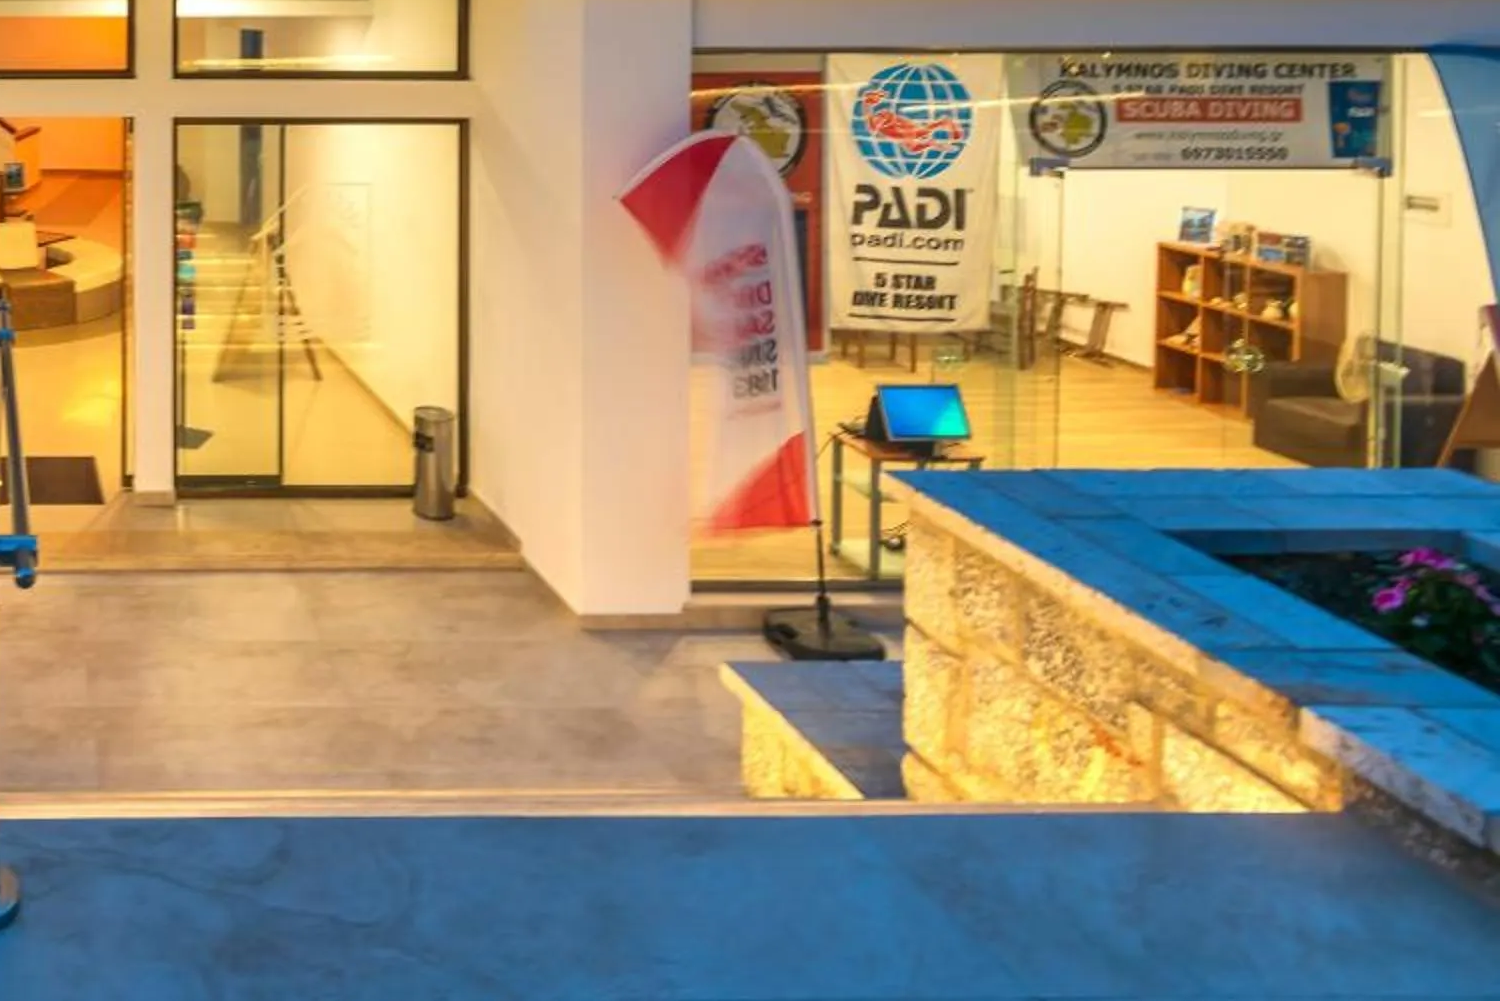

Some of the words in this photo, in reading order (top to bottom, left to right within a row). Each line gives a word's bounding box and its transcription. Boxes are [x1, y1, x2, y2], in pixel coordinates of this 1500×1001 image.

[1060, 62, 1180, 79] KALYMNOS
[1186, 62, 1268, 79] DIVING
[1273, 62, 1356, 79] CENTER
[1250, 83, 1304, 95] RESORT
[1124, 100, 1199, 119] SCUBA
[1206, 100, 1297, 119] DIVING
[852, 183, 966, 231] PADI
[850, 232, 965, 251] padi.com
[874, 272, 887, 288] 5
[892, 274, 937, 290] STAR
[852, 291, 887, 307] DIVE
[892, 293, 958, 311] RESORT
